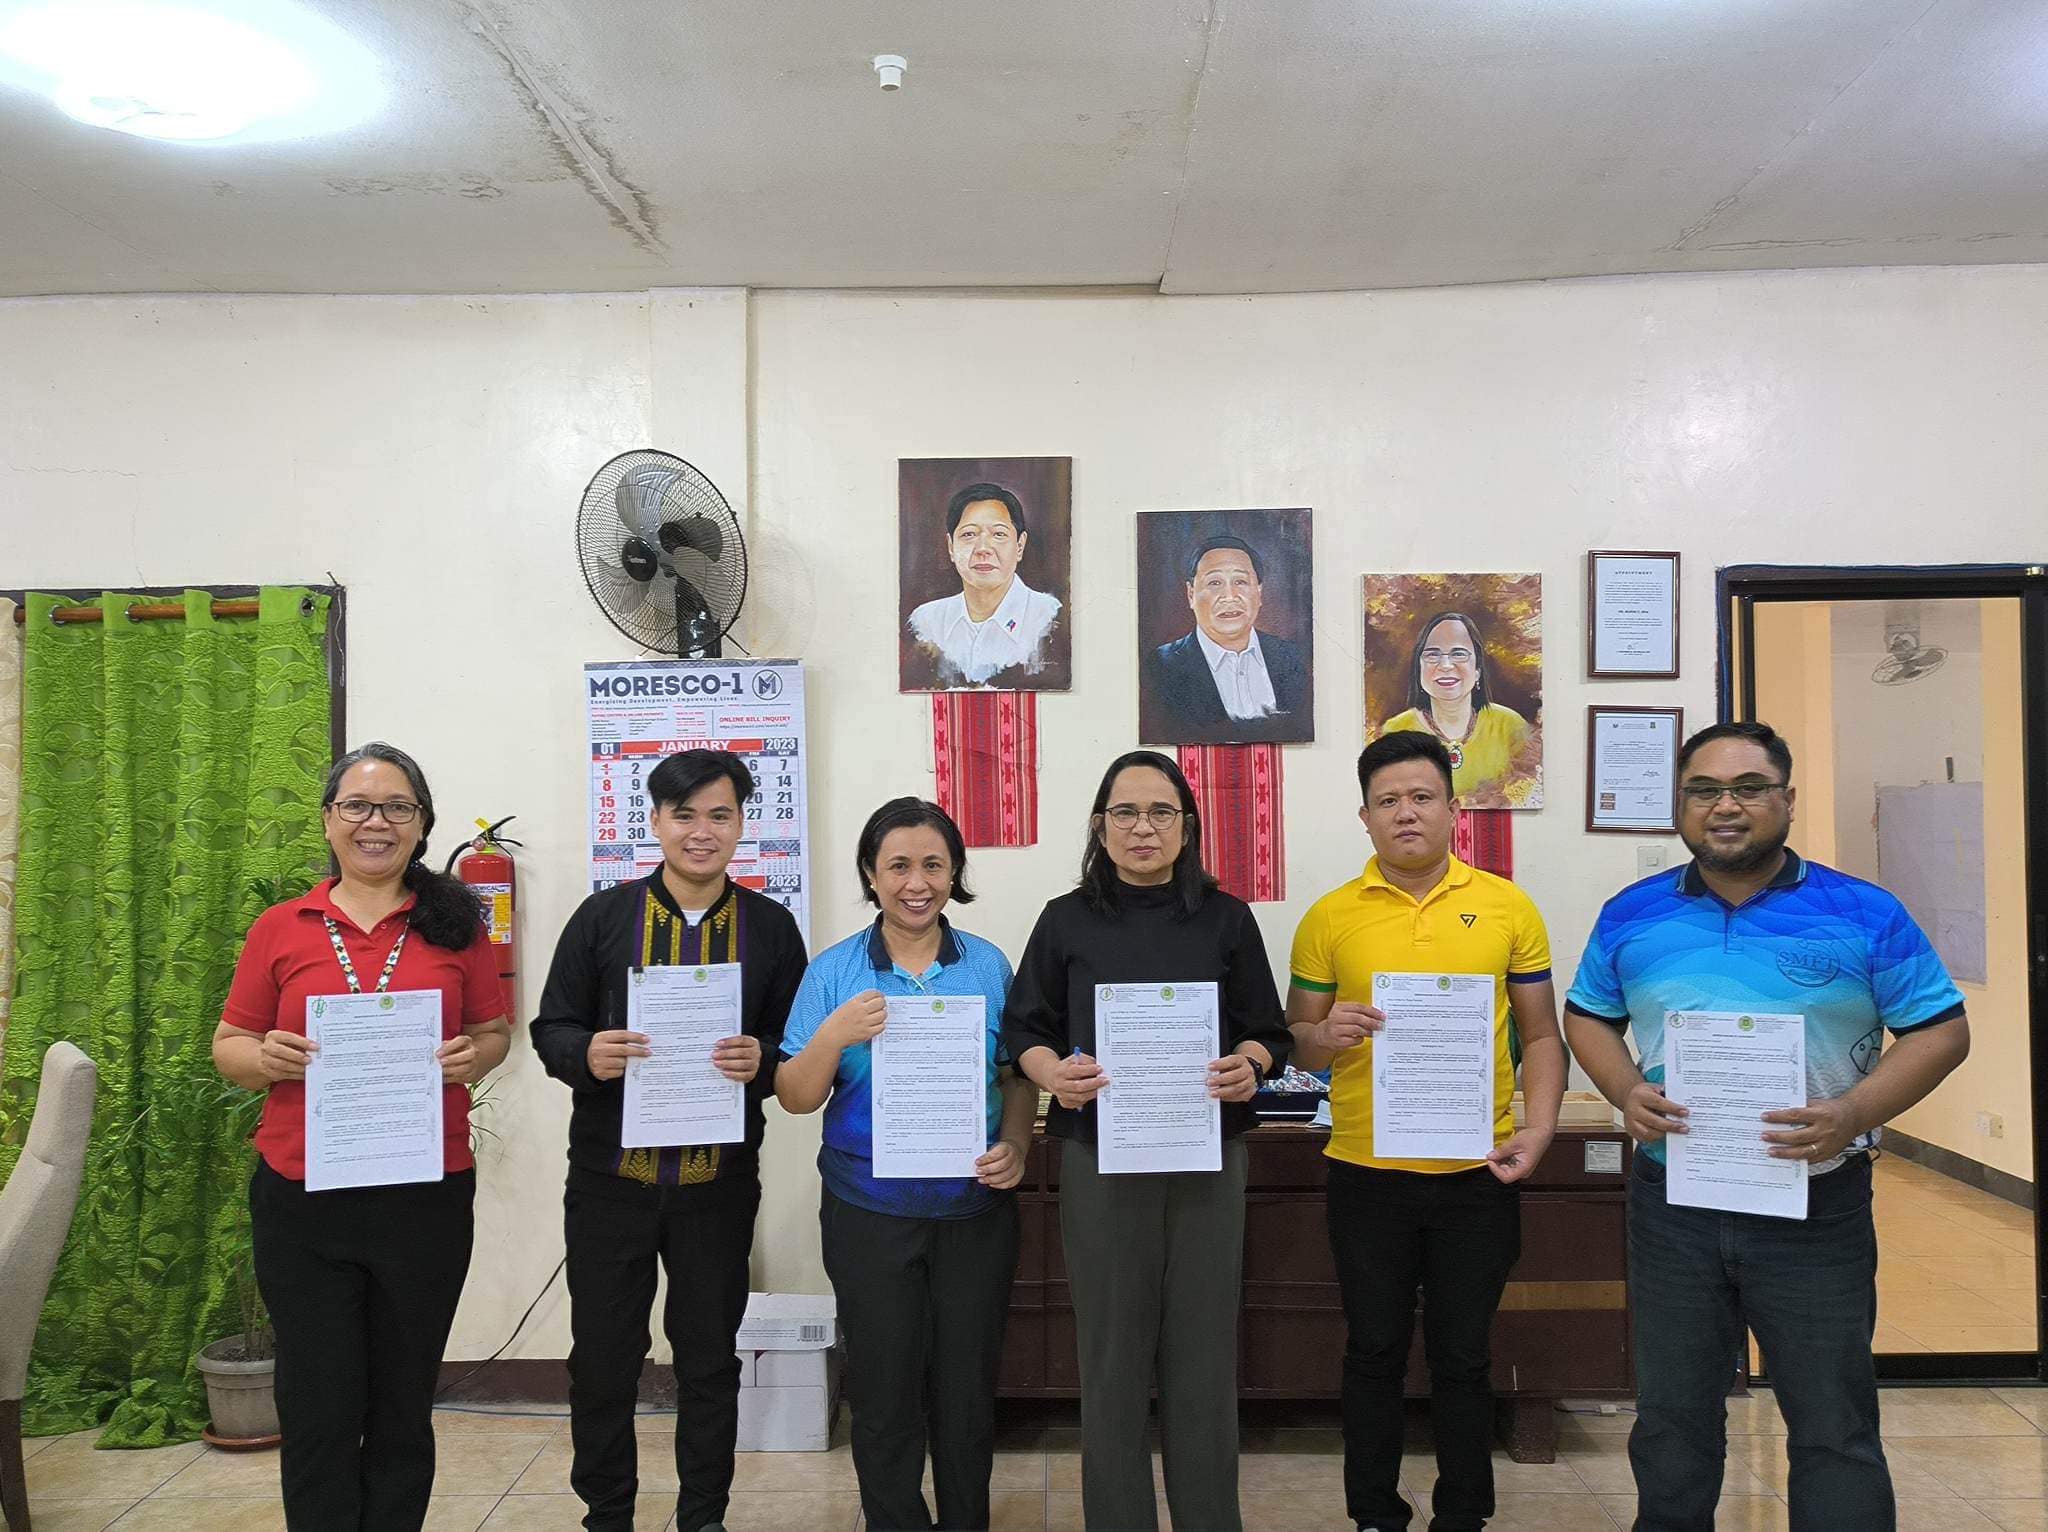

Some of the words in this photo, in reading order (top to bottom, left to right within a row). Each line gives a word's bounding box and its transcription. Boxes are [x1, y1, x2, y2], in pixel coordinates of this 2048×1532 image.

[590, 672, 744, 697] MORESCO-1
[600, 742, 614, 755] 01
[658, 740, 731, 753] JANUARY
[766, 738, 797, 750] 2023
[631, 762, 640, 775] 2
[749, 759, 758, 772] 6
[780, 759, 788, 771] 7
[602, 779, 612, 792] 8
[631, 778, 641, 791] 9
[752, 775, 762, 788] 3
[776, 775, 792, 787] 14
[600, 795, 615, 808] 15
[628, 794, 644, 807] 16
[776, 791, 792, 804] 21
[598, 812, 616, 824] 22
[627, 811, 645, 823] 23
[746, 808, 762, 820] 27
[776, 807, 794, 820] 28
[598, 828, 616, 840] 29
[627, 827, 645, 840] 30
[768, 875, 799, 887] 2023
[782, 896, 791, 908] 4
